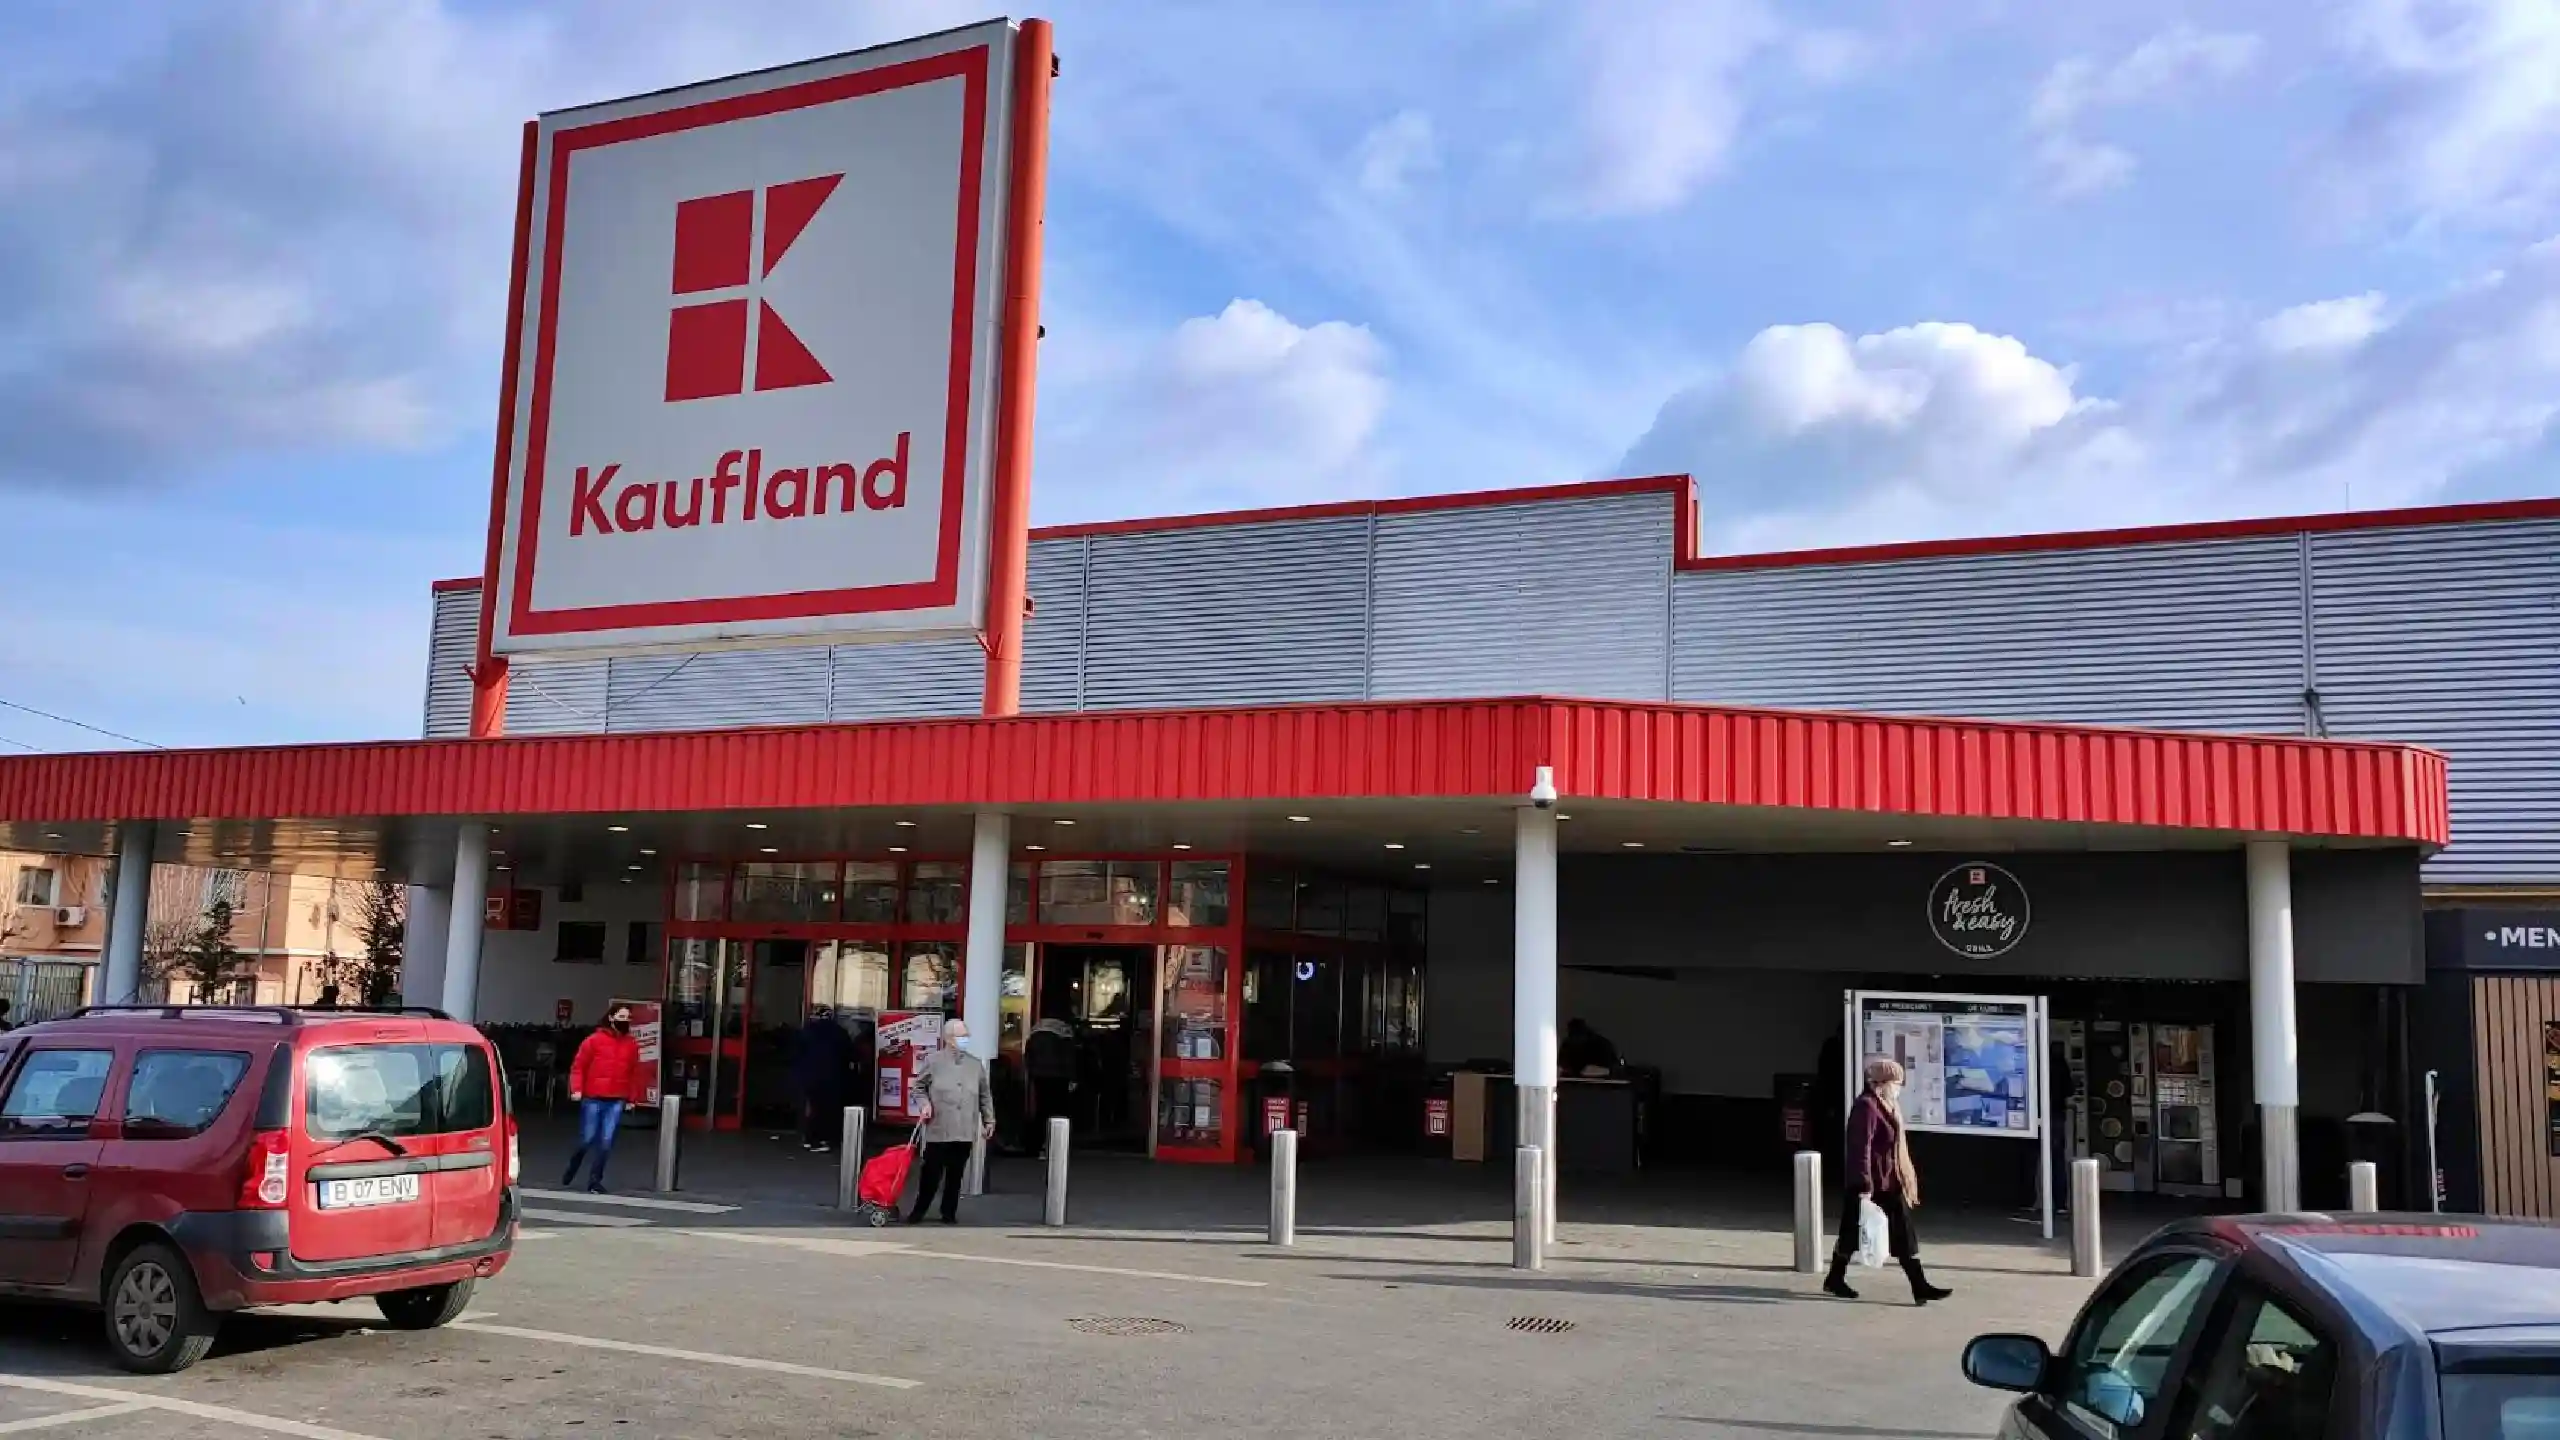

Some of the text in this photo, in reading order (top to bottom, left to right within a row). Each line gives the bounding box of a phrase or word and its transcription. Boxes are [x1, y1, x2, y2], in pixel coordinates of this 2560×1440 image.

[570, 431, 911, 537] Kaufland
[1943, 885, 1998, 922] fresh
[335, 1176, 413, 1201] B 07 ENV
